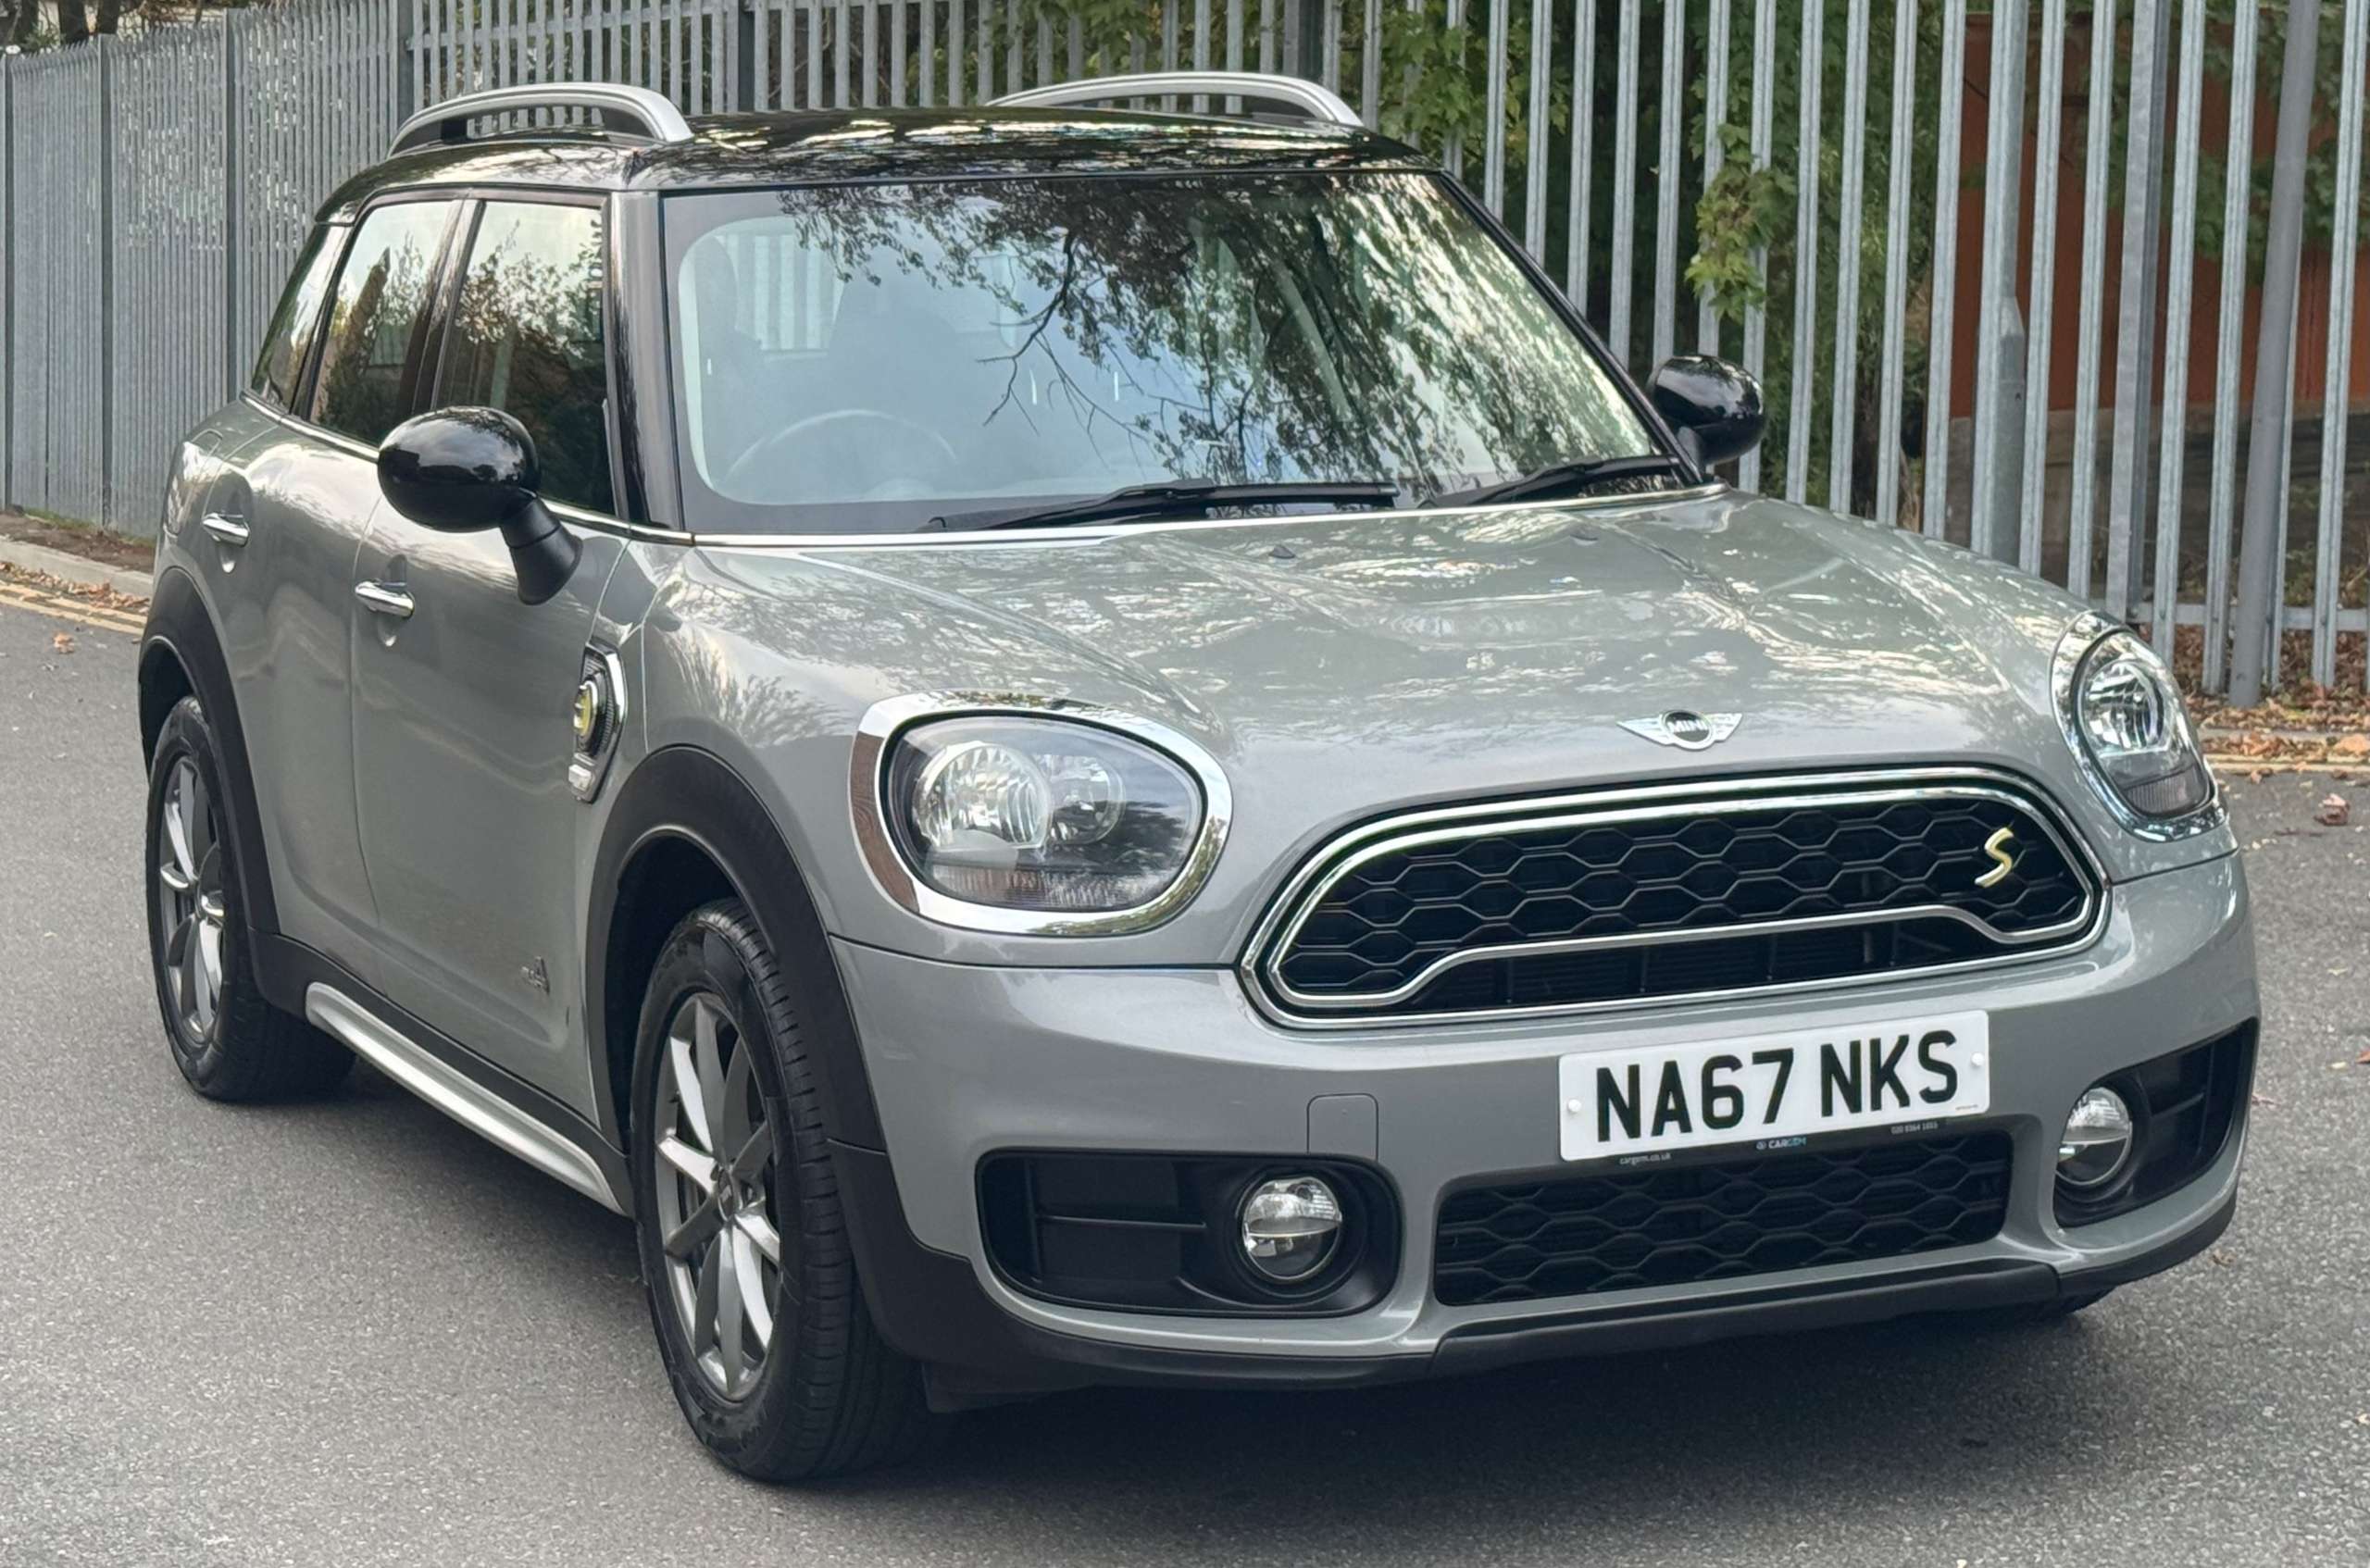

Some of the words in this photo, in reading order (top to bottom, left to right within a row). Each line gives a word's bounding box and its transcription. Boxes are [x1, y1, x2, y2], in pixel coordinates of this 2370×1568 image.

[1666, 719, 1708, 733] MINI
[1975, 827, 2014, 888] S
[1597, 1048, 1794, 1142] NA67
[1820, 1030, 1957, 1117] NKS
